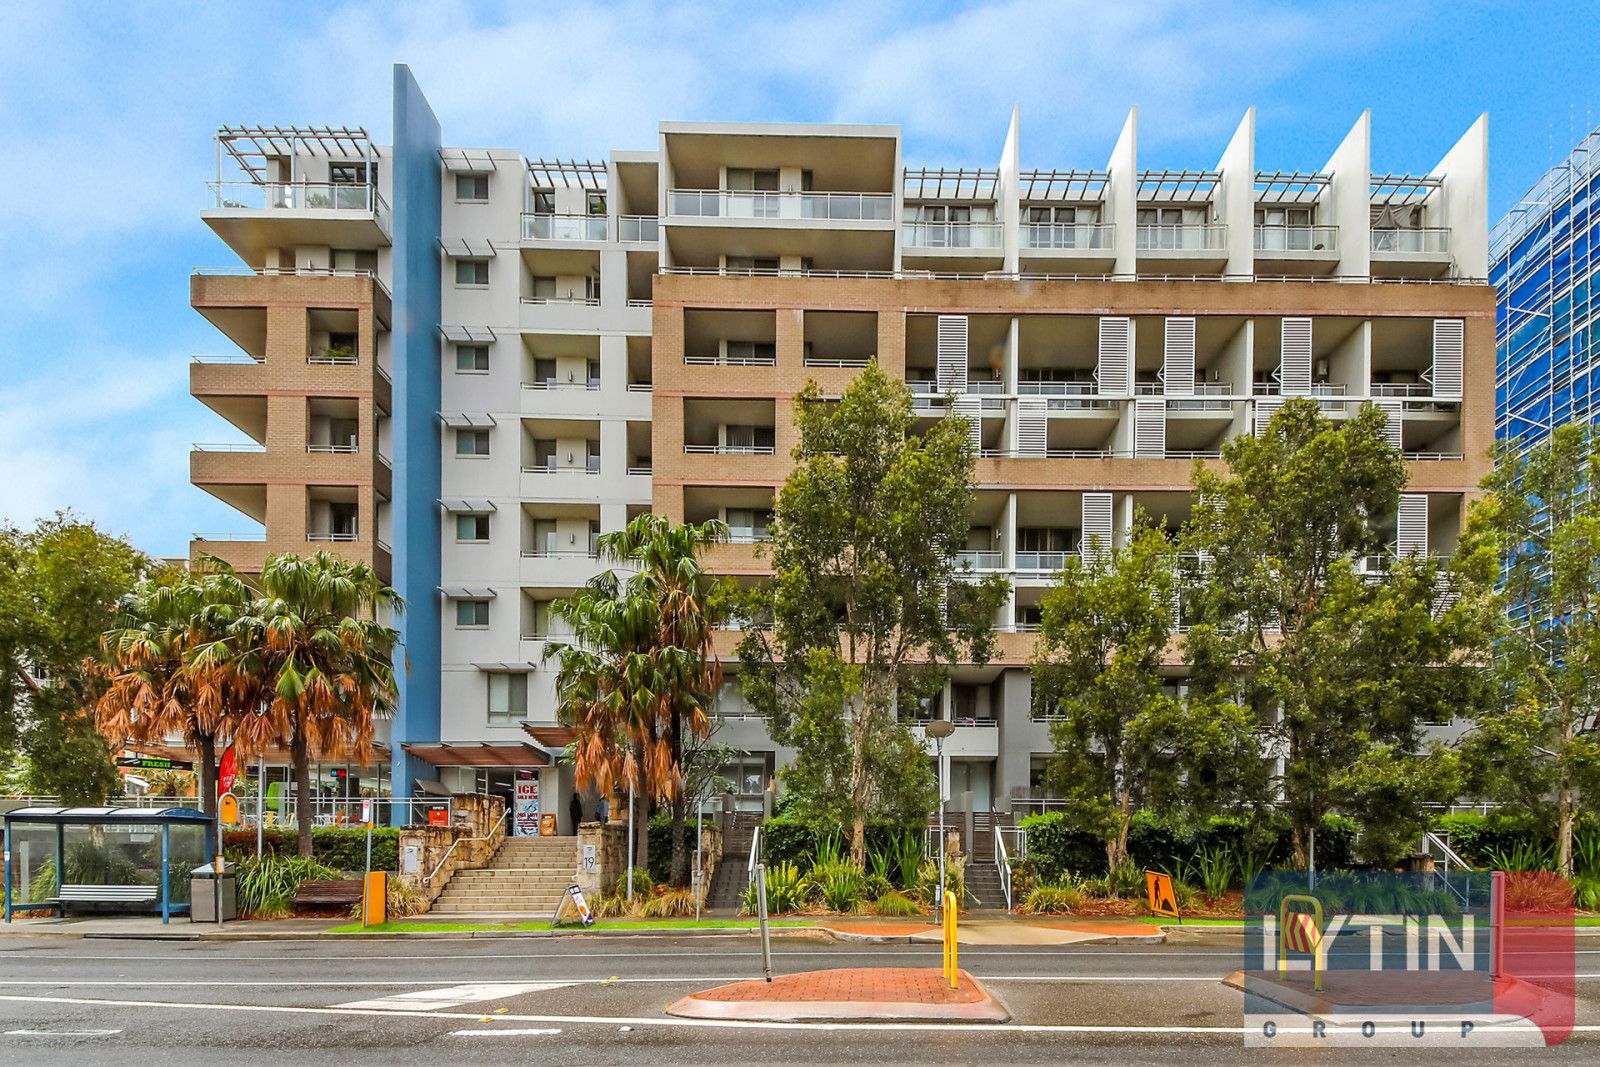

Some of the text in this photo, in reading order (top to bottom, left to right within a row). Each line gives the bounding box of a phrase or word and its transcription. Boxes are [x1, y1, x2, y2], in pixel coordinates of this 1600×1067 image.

[141, 760, 171, 768] FRESH
[517, 784, 538, 794] ICE
[584, 856, 595, 869] 19
